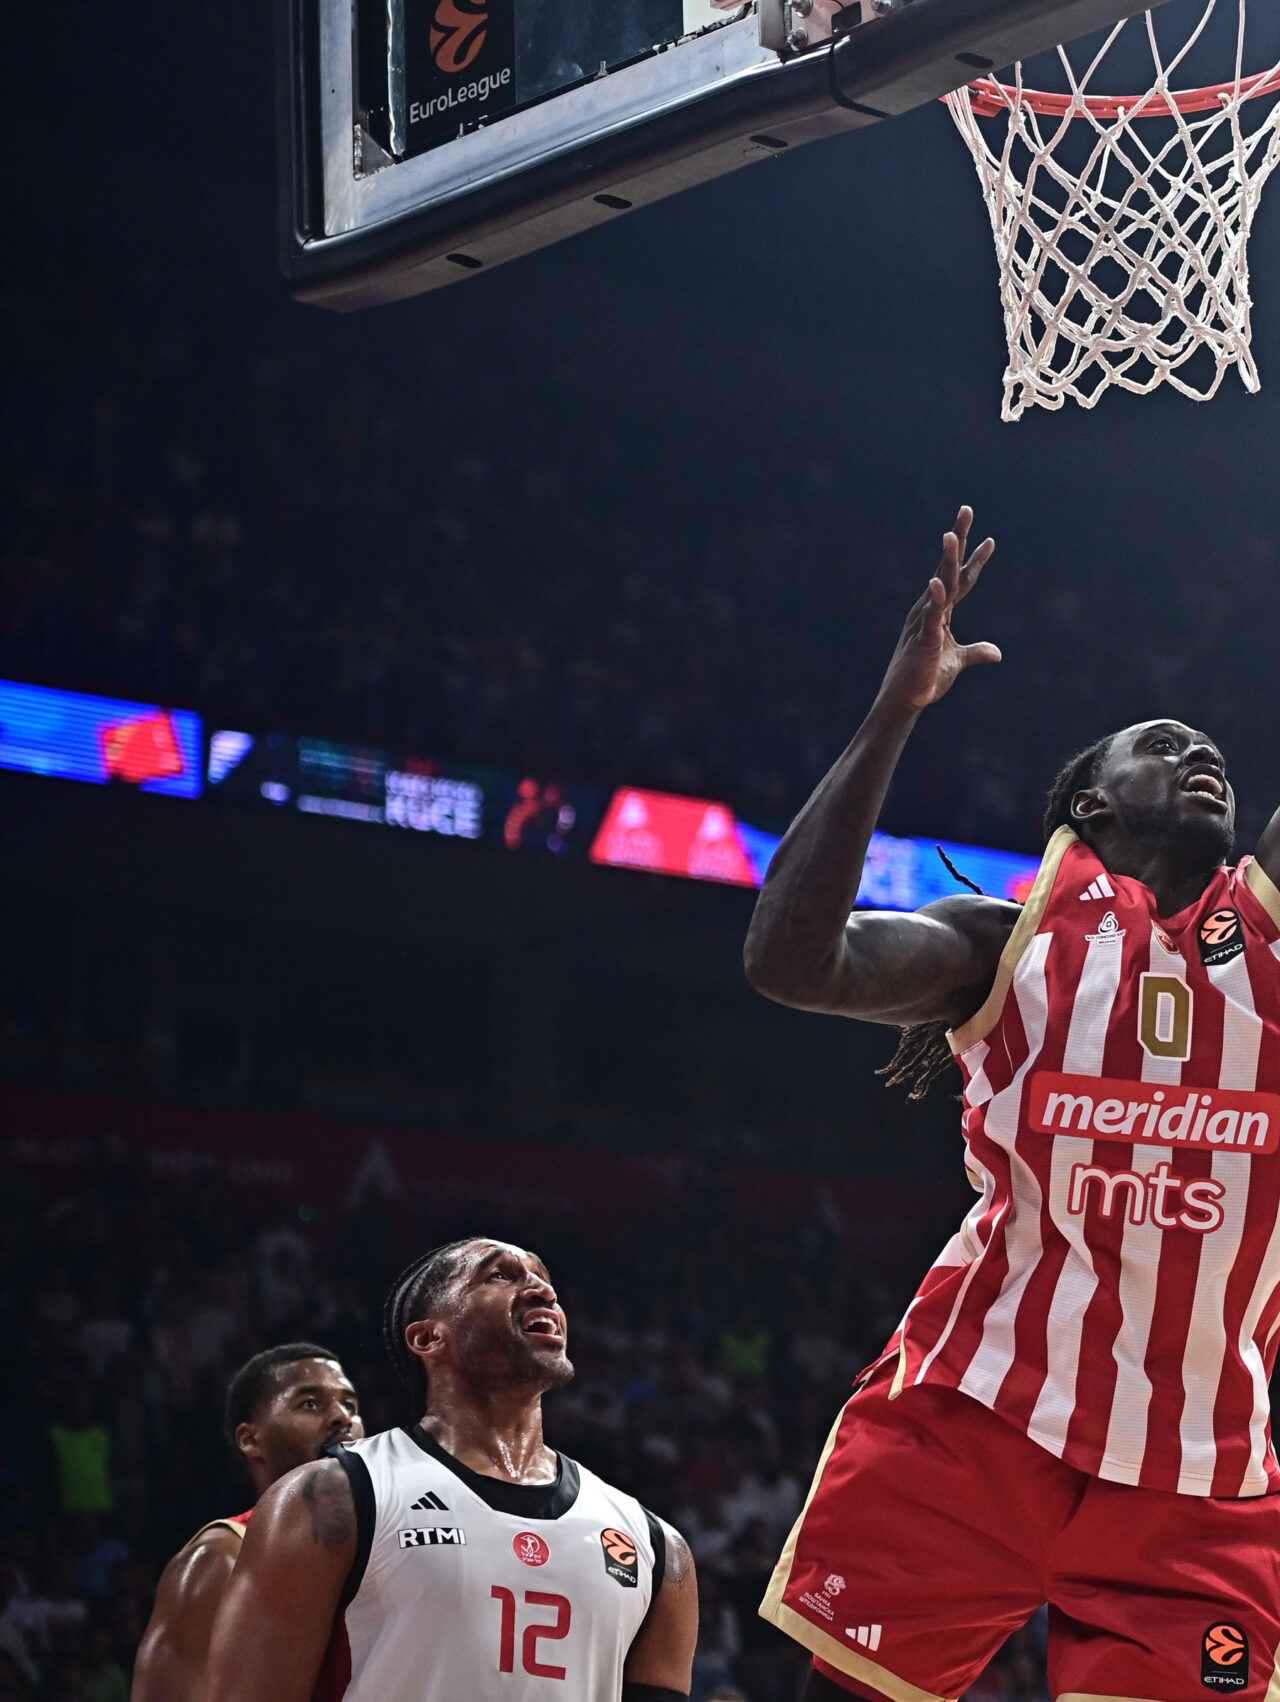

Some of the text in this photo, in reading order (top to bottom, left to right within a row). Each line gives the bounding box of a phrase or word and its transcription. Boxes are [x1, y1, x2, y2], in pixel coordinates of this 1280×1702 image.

[409, 67, 511, 124] EuroLeague
[1203, 943, 1243, 963] ETIHAD
[1138, 972, 1193, 1061] 0
[1041, 1090, 1269, 1147] meridian
[1069, 1162, 1224, 1232] mts
[814, 1592, 831, 1607] БАНКА
[491, 1584, 571, 1680] 12
[1203, 1675, 1245, 1685] ETIHAD
